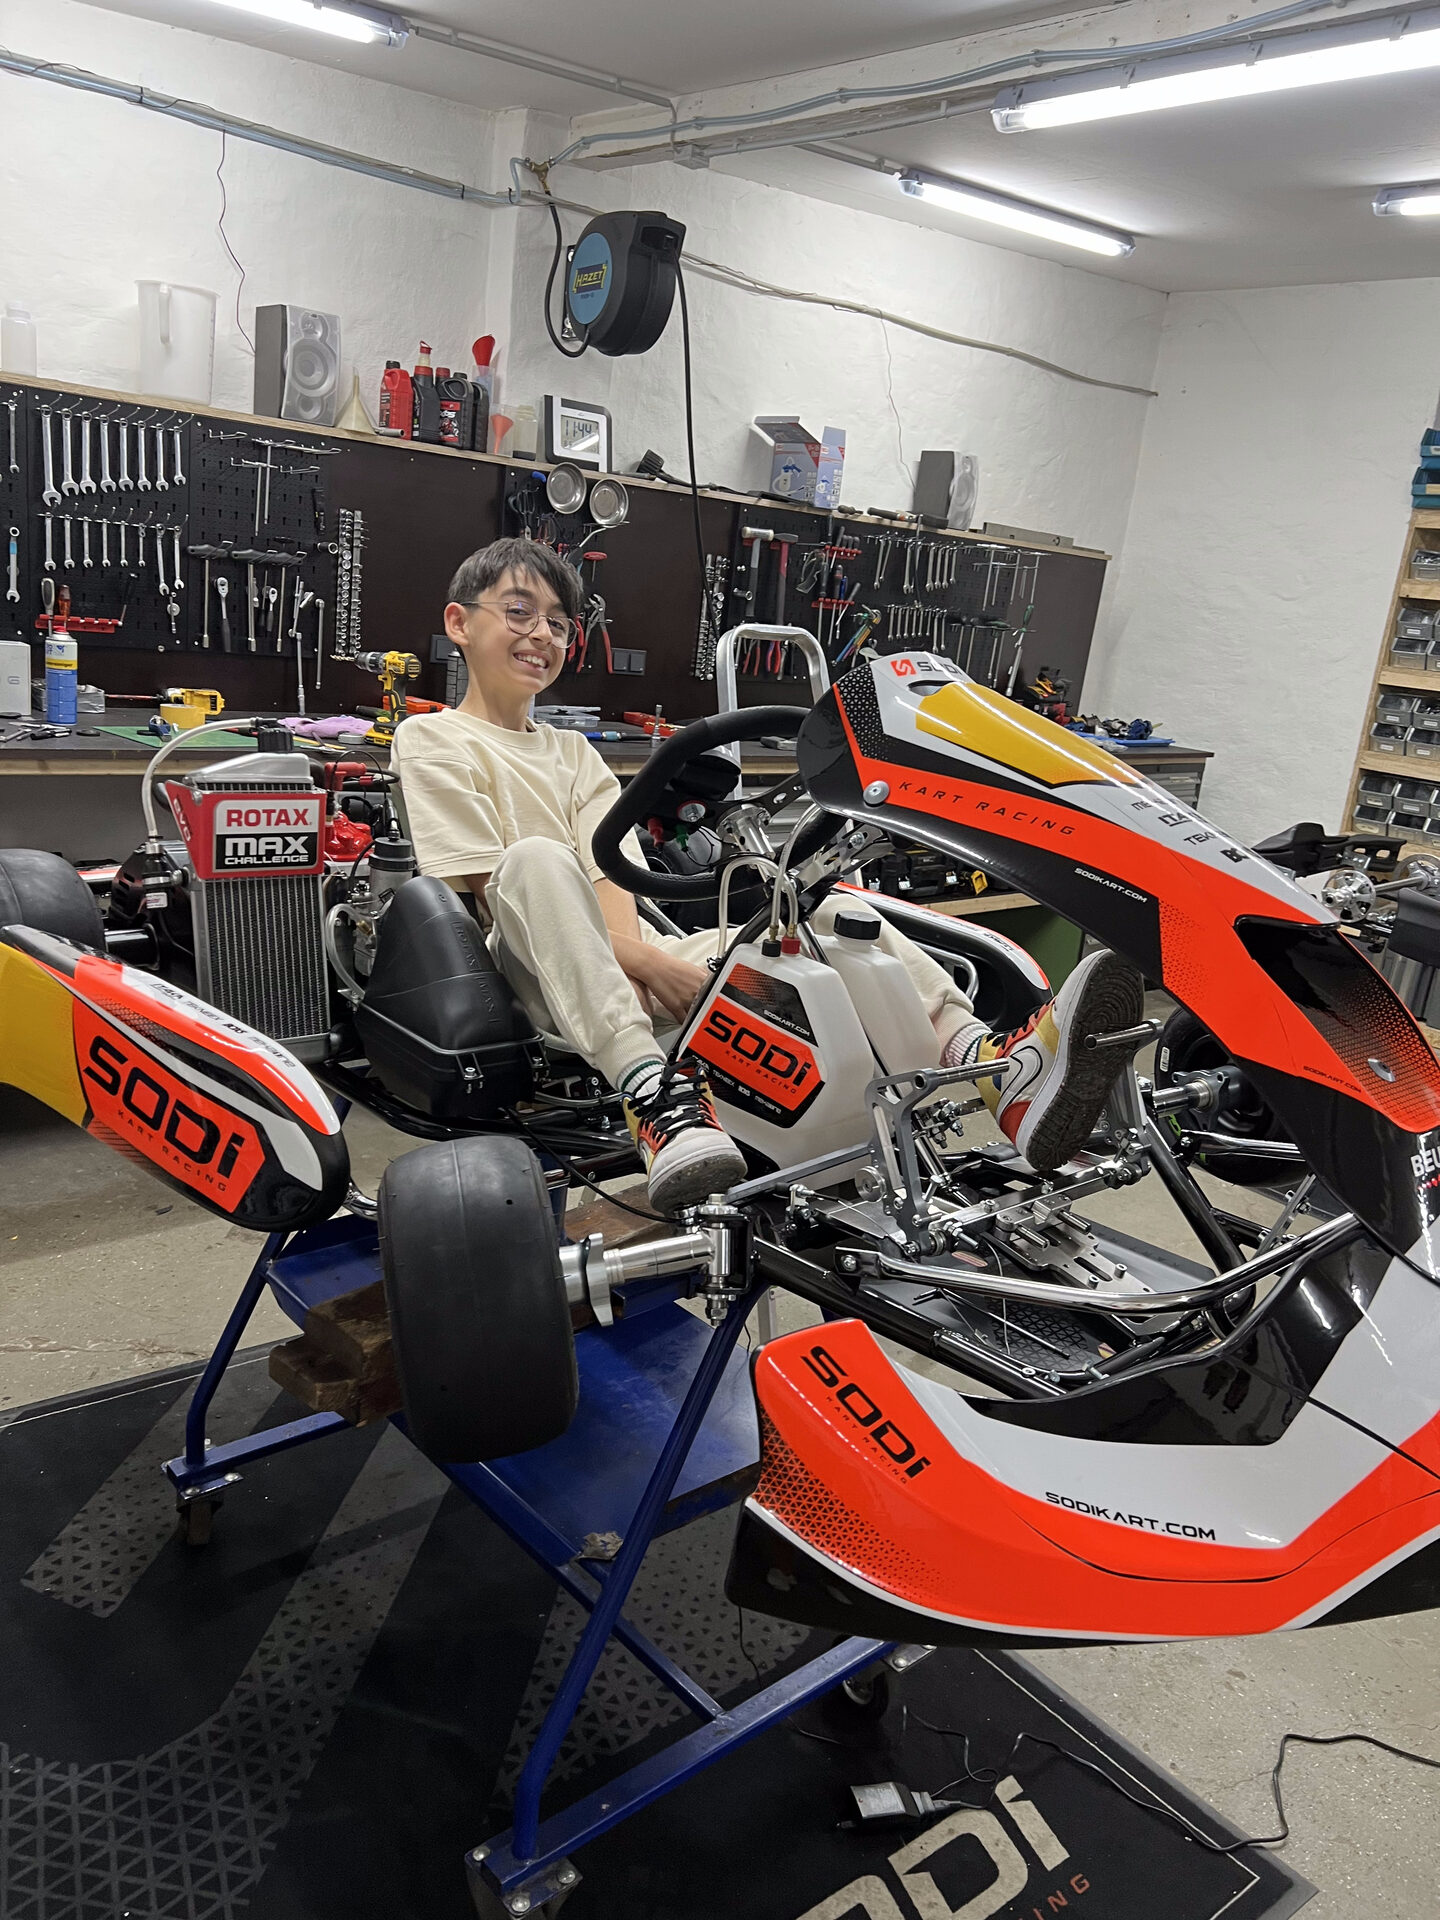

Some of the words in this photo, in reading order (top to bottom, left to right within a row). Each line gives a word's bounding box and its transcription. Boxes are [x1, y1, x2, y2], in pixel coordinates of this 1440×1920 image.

[574, 269, 604, 289] HAZET
[226, 808, 309, 827] ROTAX
[899, 781, 964, 804] KART
[976, 801, 1076, 836] RACING
[224, 854, 309, 865] CHALLENGE
[225, 836, 309, 857] MAX
[1074, 867, 1148, 903] SODIKART.COM
[763, 1009, 810, 1038] SODIKART.COM
[703, 1010, 813, 1087] SODi
[725, 1050, 751, 1068] KART
[756, 1069, 798, 1094] RACING
[83, 1035, 245, 1179] SODi
[117, 1109, 154, 1142] KART
[162, 1146, 227, 1192] RACING
[800, 1345, 932, 1479] SODi
[826, 1396, 858, 1429] KART
[862, 1436, 908, 1484] RACING
[1045, 1491, 1217, 1541] SODIKART.COM
